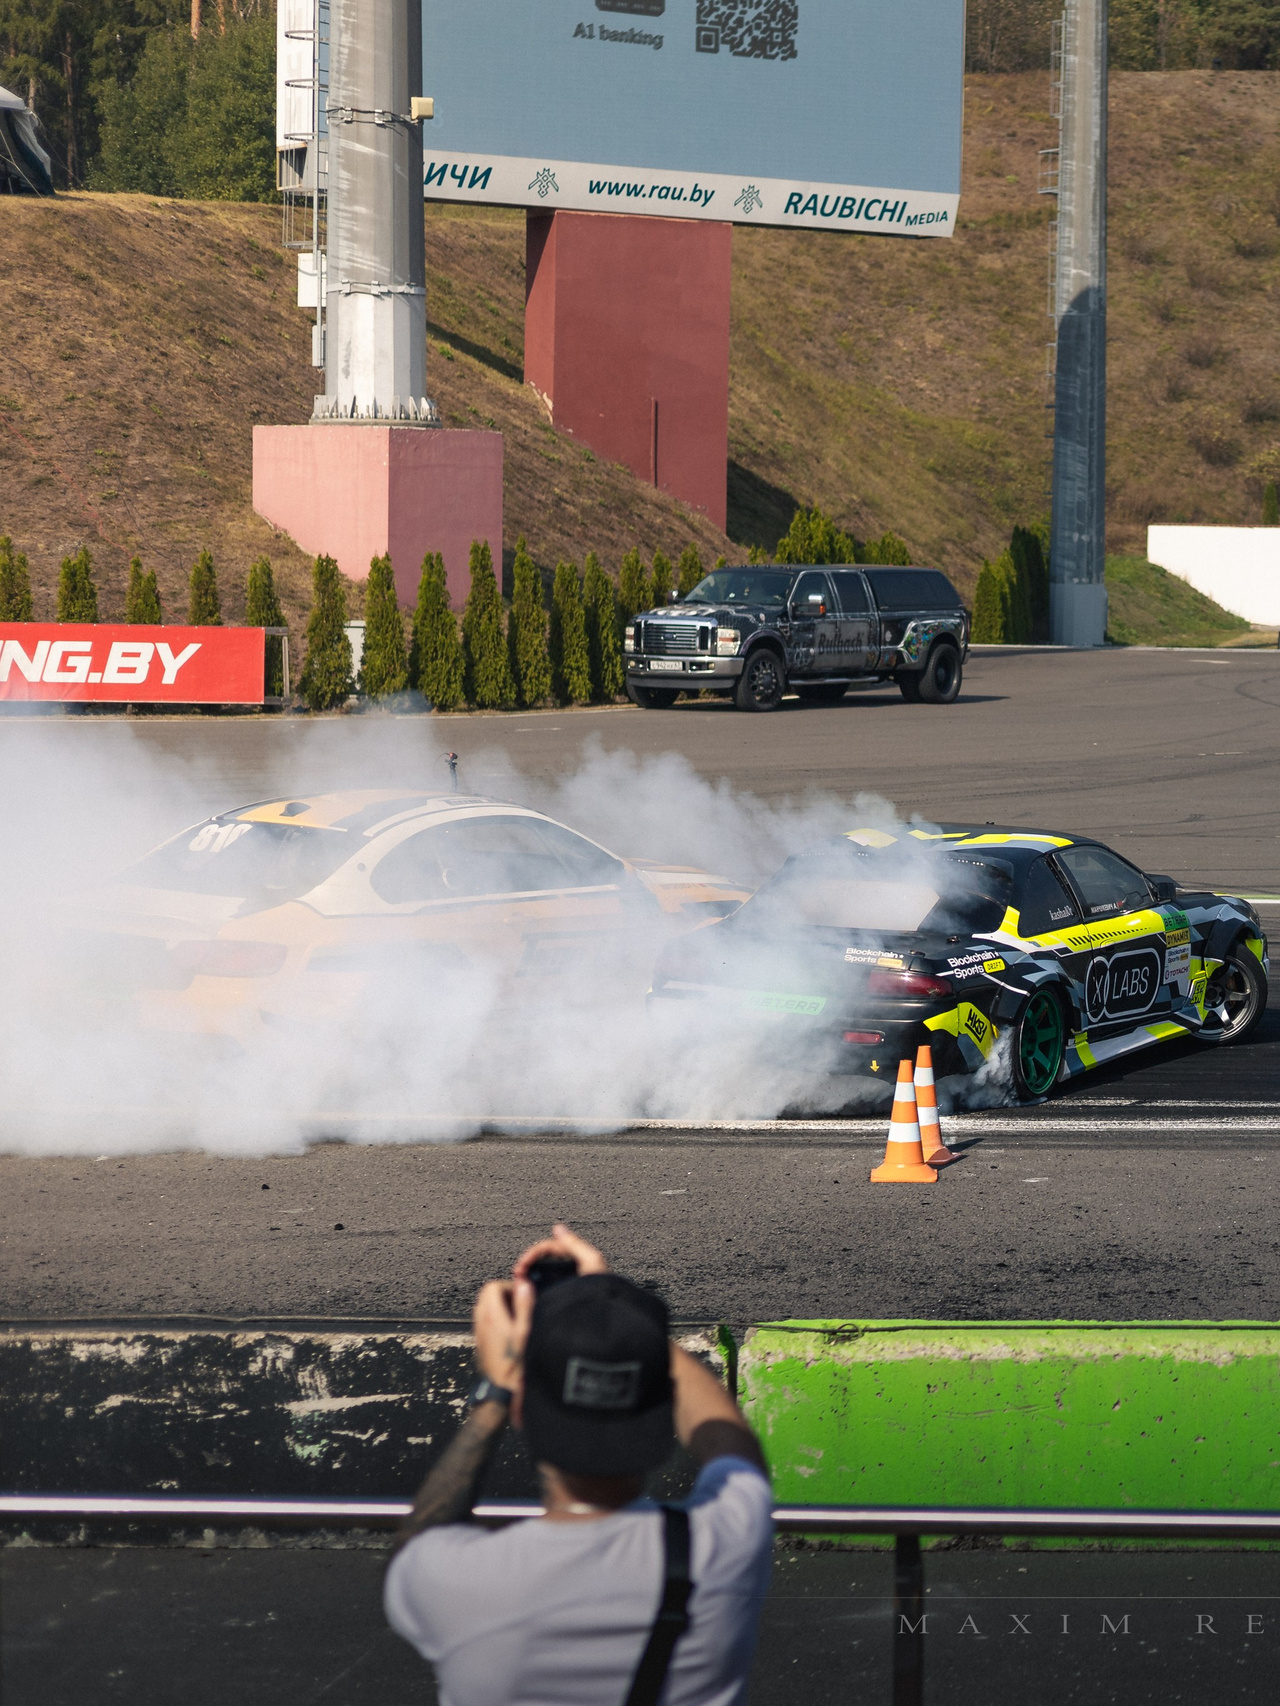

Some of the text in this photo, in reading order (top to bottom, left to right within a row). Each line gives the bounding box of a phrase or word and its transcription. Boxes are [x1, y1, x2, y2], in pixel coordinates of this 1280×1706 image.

[572, 21, 664, 50] A1 banking
[423, 161, 493, 190] ИЧИ
[588, 177, 716, 208] www.rau.by
[783, 191, 949, 227] RAUBICHI MEDIA
[818, 632, 863, 656] Bulbash
[0, 640, 203, 685] NG.BY
[844, 954, 877, 964] Sports
[846, 947, 898, 959] Blockchain
[947, 950, 996, 968] Blockchain
[953, 963, 985, 979] Sports
[1112, 966, 1150, 1000] LABS
